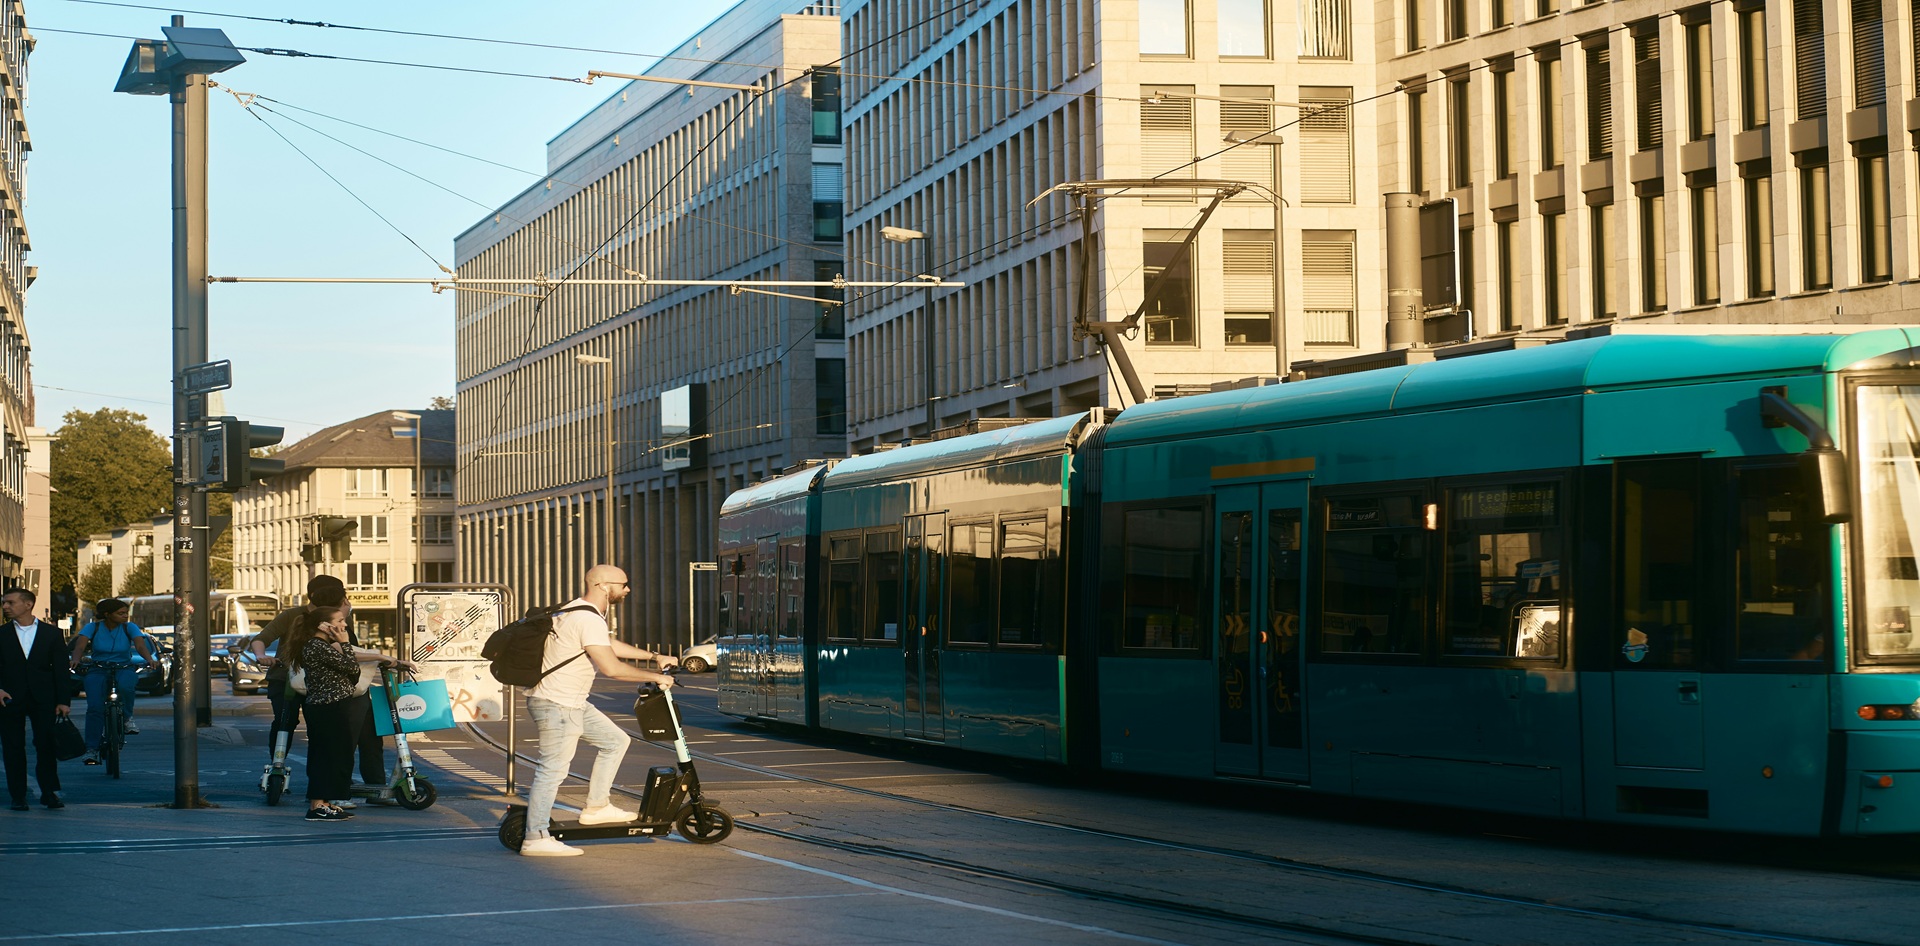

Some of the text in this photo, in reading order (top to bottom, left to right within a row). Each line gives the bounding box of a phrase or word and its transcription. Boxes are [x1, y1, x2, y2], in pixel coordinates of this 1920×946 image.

[1871, 397, 1906, 441] 11
[1461, 492, 1473, 518] 11
[435, 645, 480, 657] ZONE
